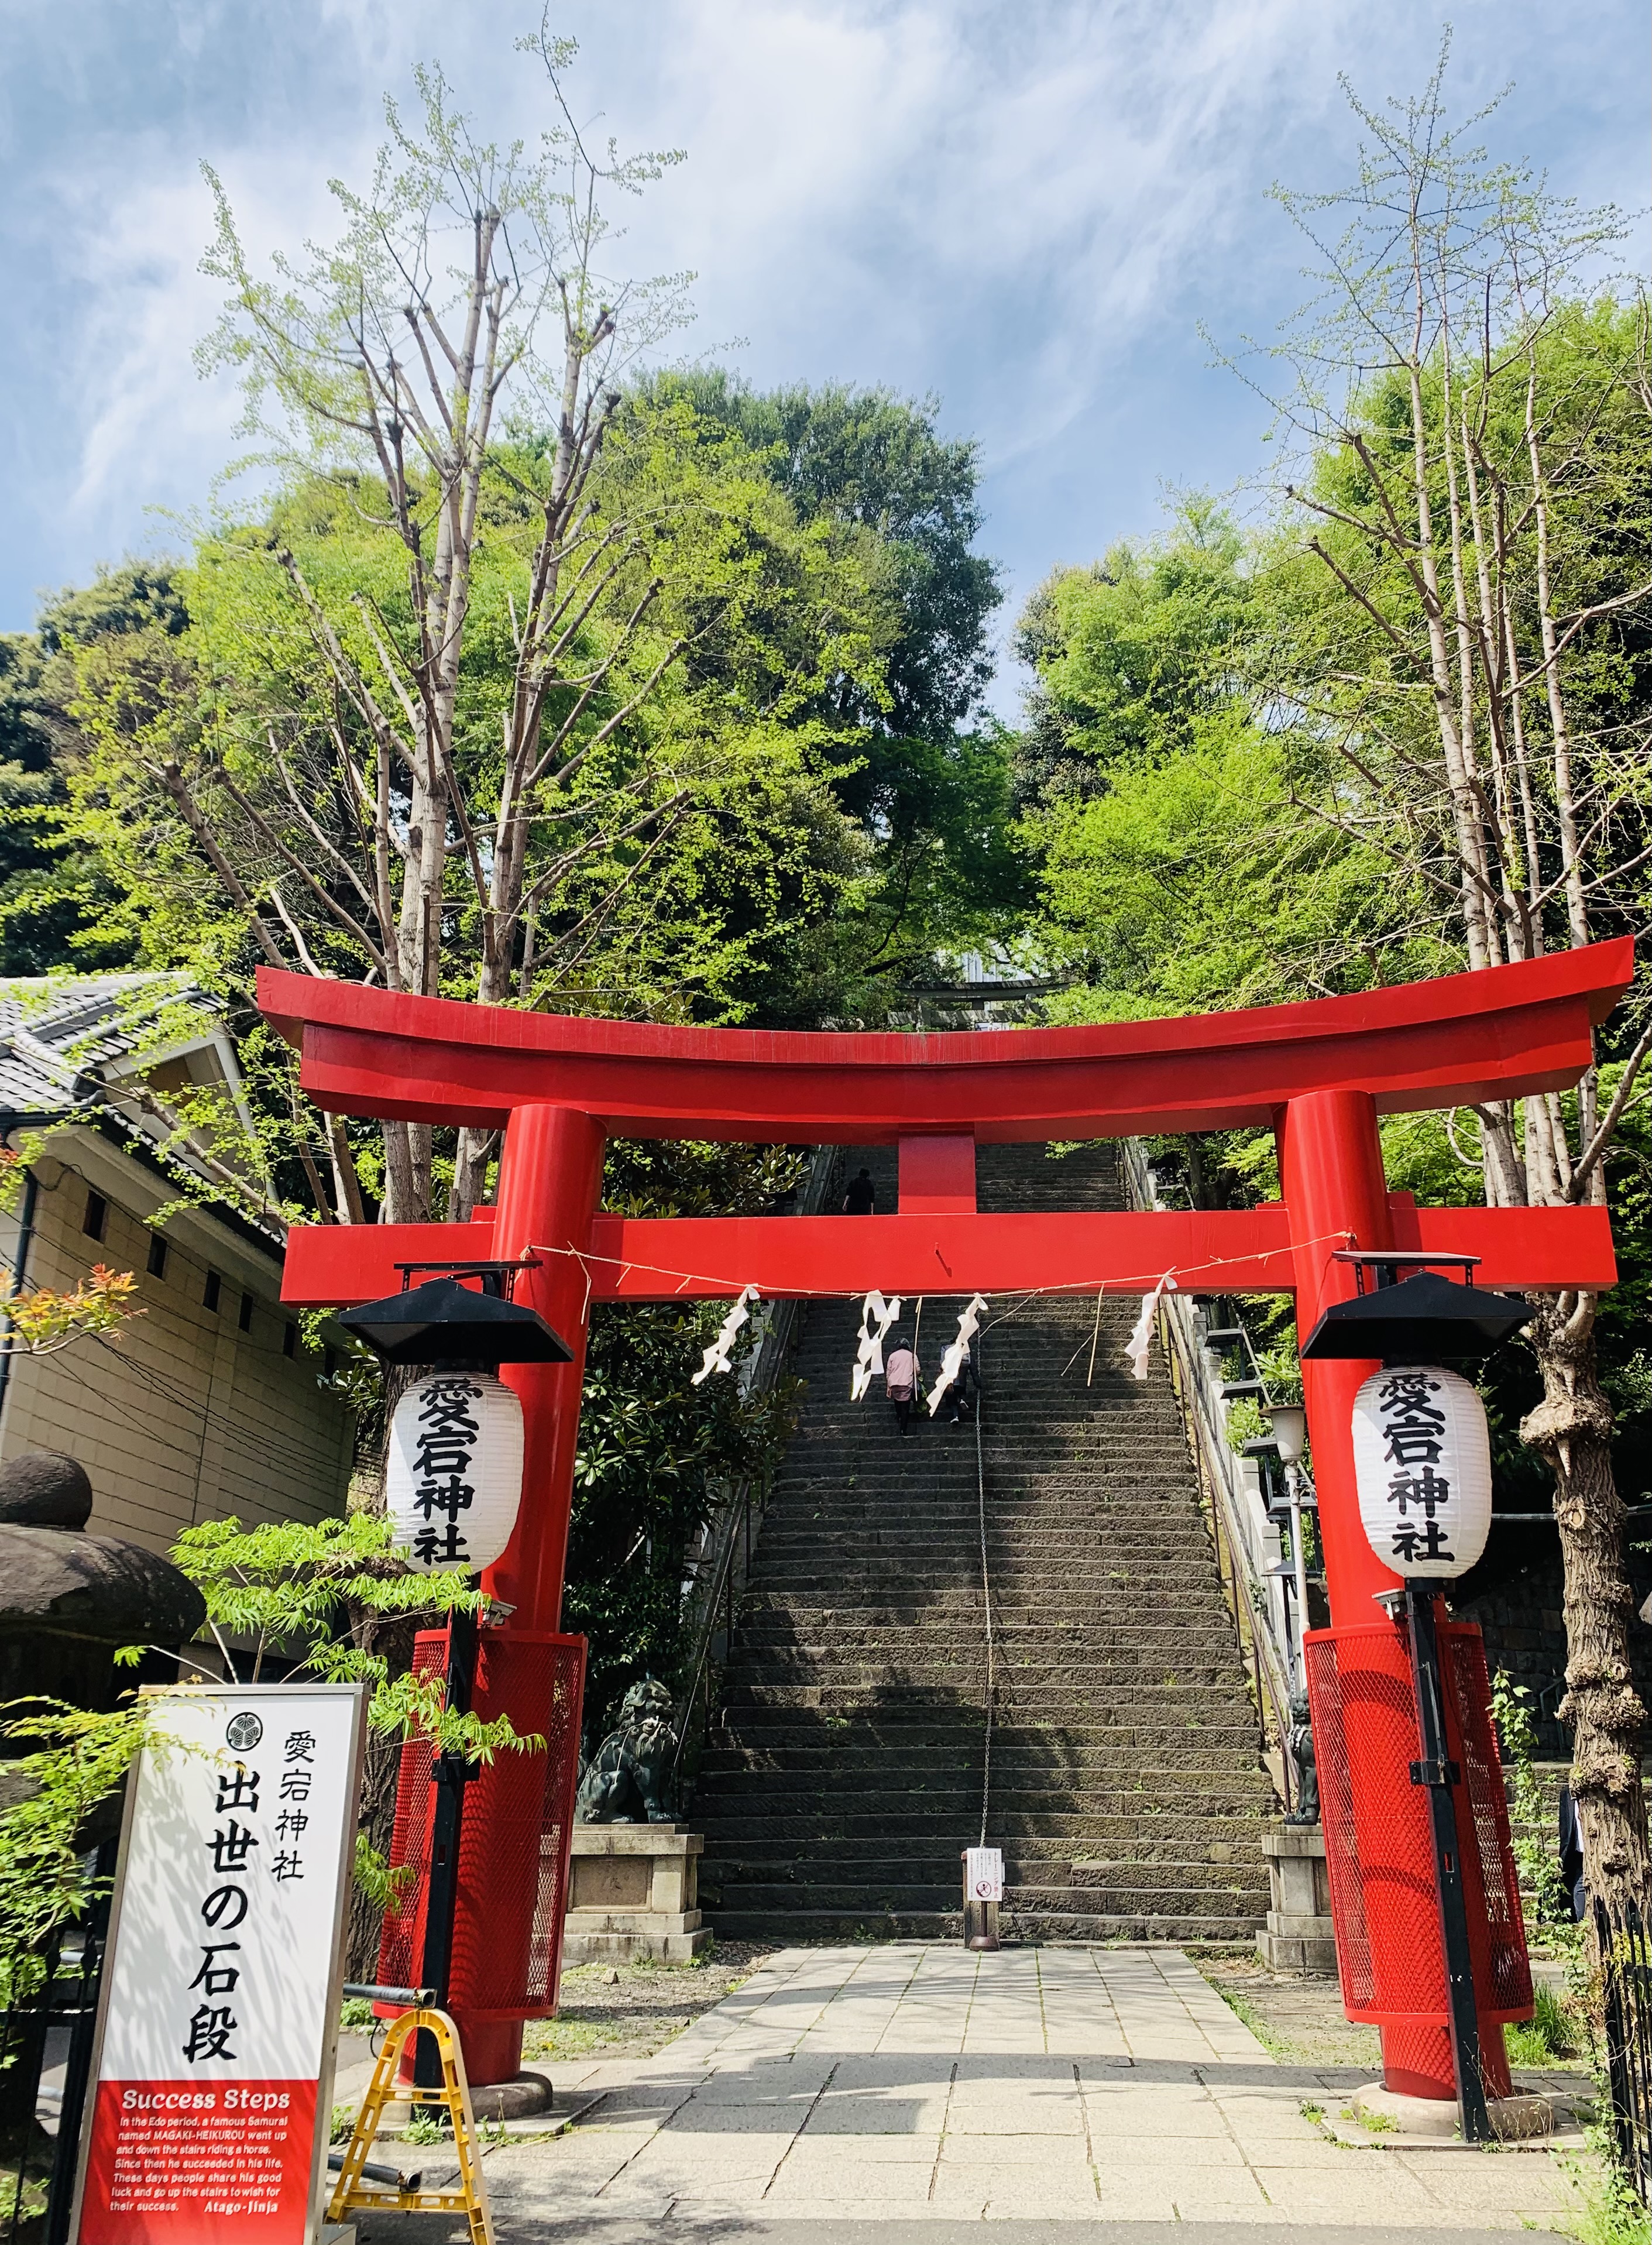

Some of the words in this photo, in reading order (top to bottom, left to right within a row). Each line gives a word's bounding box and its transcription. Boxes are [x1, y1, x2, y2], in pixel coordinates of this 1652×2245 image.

[413, 1377, 483, 1565] 愛宕神社
[1378, 1372, 1455, 1563] 愛宕神社
[270, 1730, 317, 1882] 愛宕神社
[182, 1759, 259, 2064] 出世の石段
[122, 2089, 216, 2109] Success
[224, 2088, 290, 2112] Steps
[120, 2116, 129, 2126] In
[131, 2116, 147, 2126] the
[148, 2116, 166, 2126] Edo
[202, 2117, 208, 2126] a
[210, 2116, 246, 2126] famous
[248, 2116, 288, 2126] Samurai
[118, 2130, 152, 2140] named
[153, 2130, 245, 2140] MAGAKI-HEIKUROU
[248, 2130, 273, 2140] went
[274, 2131, 287, 2141] up
[116, 2144, 134, 2154] and
[135, 2144, 160, 2154] down
[162, 2144, 178, 2154] the
[179, 2144, 205, 2154] stairs
[207, 2144, 234, 2155] riding
[235, 2146, 242, 2154] a
[115, 2158, 141, 2169] Since
[144, 2158, 166, 2168] then
[167, 2158, 180, 2168] he
[182, 2158, 234, 2168] succeeded
[236, 2158, 246, 2168] in
[248, 2158, 263, 2168] his
[113, 2172, 143, 2183] These
[145, 2172, 169, 2184] days
[170, 2172, 205, 2184] people
[207, 2172, 236, 2182] share
[239, 2172, 255, 2182] his
[256, 2172, 282, 2184] good
[111, 2186, 132, 2197] luck
[133, 2186, 153, 2197] and
[153, 2188, 166, 2198] go
[167, 2188, 181, 2198] up
[182, 2186, 198, 2197] the
[200, 2186, 229, 2197] stairs
[231, 2186, 241, 2197] to
[242, 2186, 264, 2197] wish
[266, 2186, 281, 2197] for
[109, 2201, 135, 2211] their
[136, 2202, 180, 2211] success.
[204, 2200, 279, 2215] Atago-Jinja
